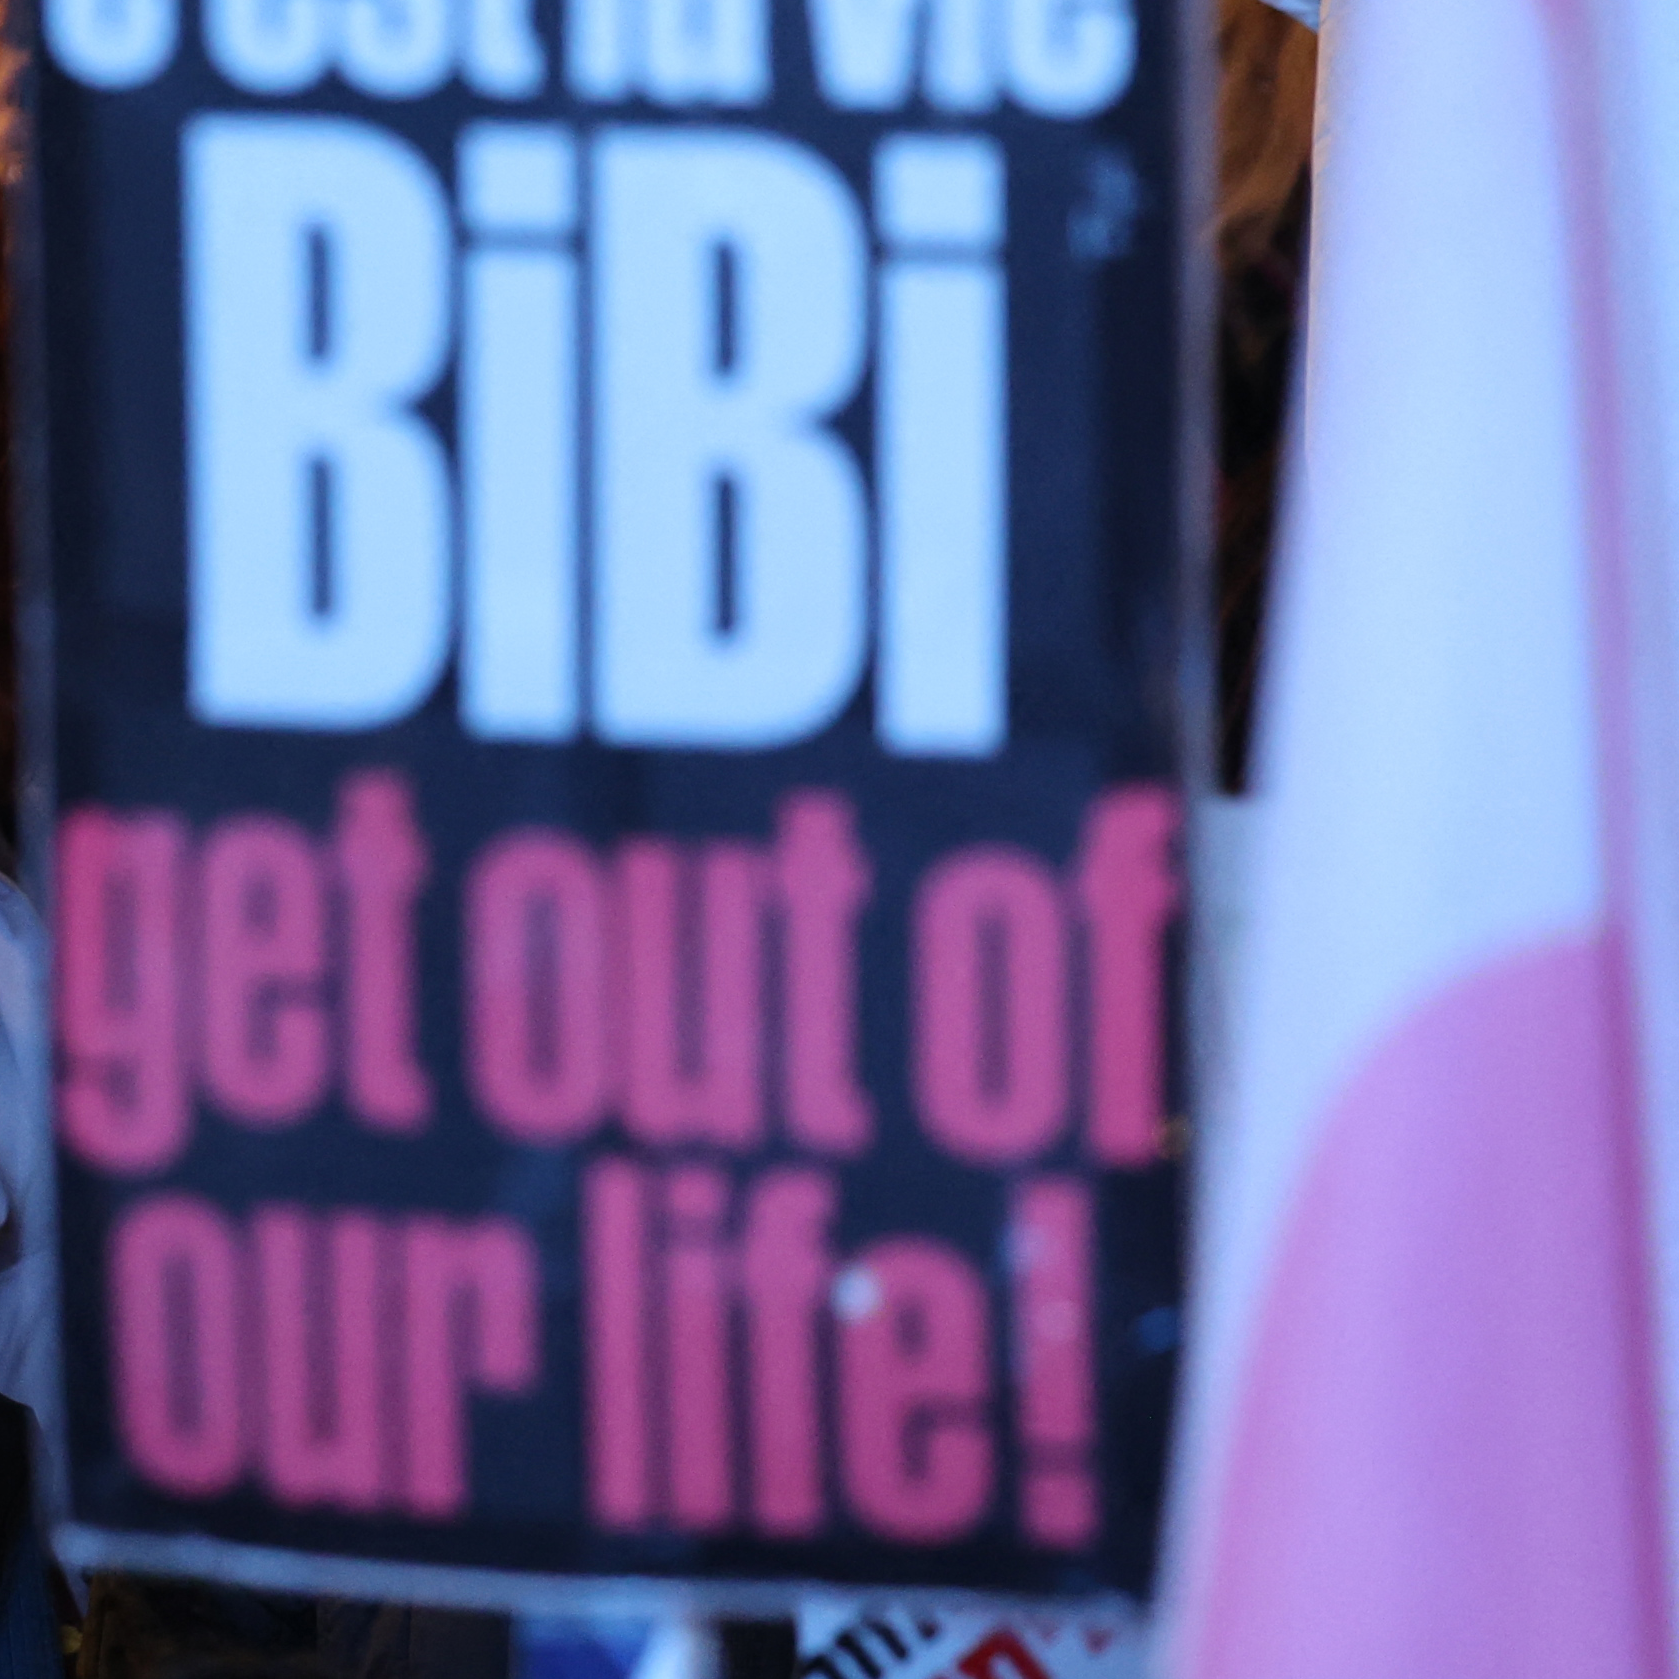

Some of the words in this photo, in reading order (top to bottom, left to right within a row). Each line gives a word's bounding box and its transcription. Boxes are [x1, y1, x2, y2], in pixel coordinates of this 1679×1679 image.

[180, 111, 1011, 761] BiBi
[56, 764, 433, 1179] get
[459, 785, 877, 1160] out
[908, 779, 1183, 1172] of
[104, 1190, 542, 1520] our
[579, 1153, 1100, 1554] life!
